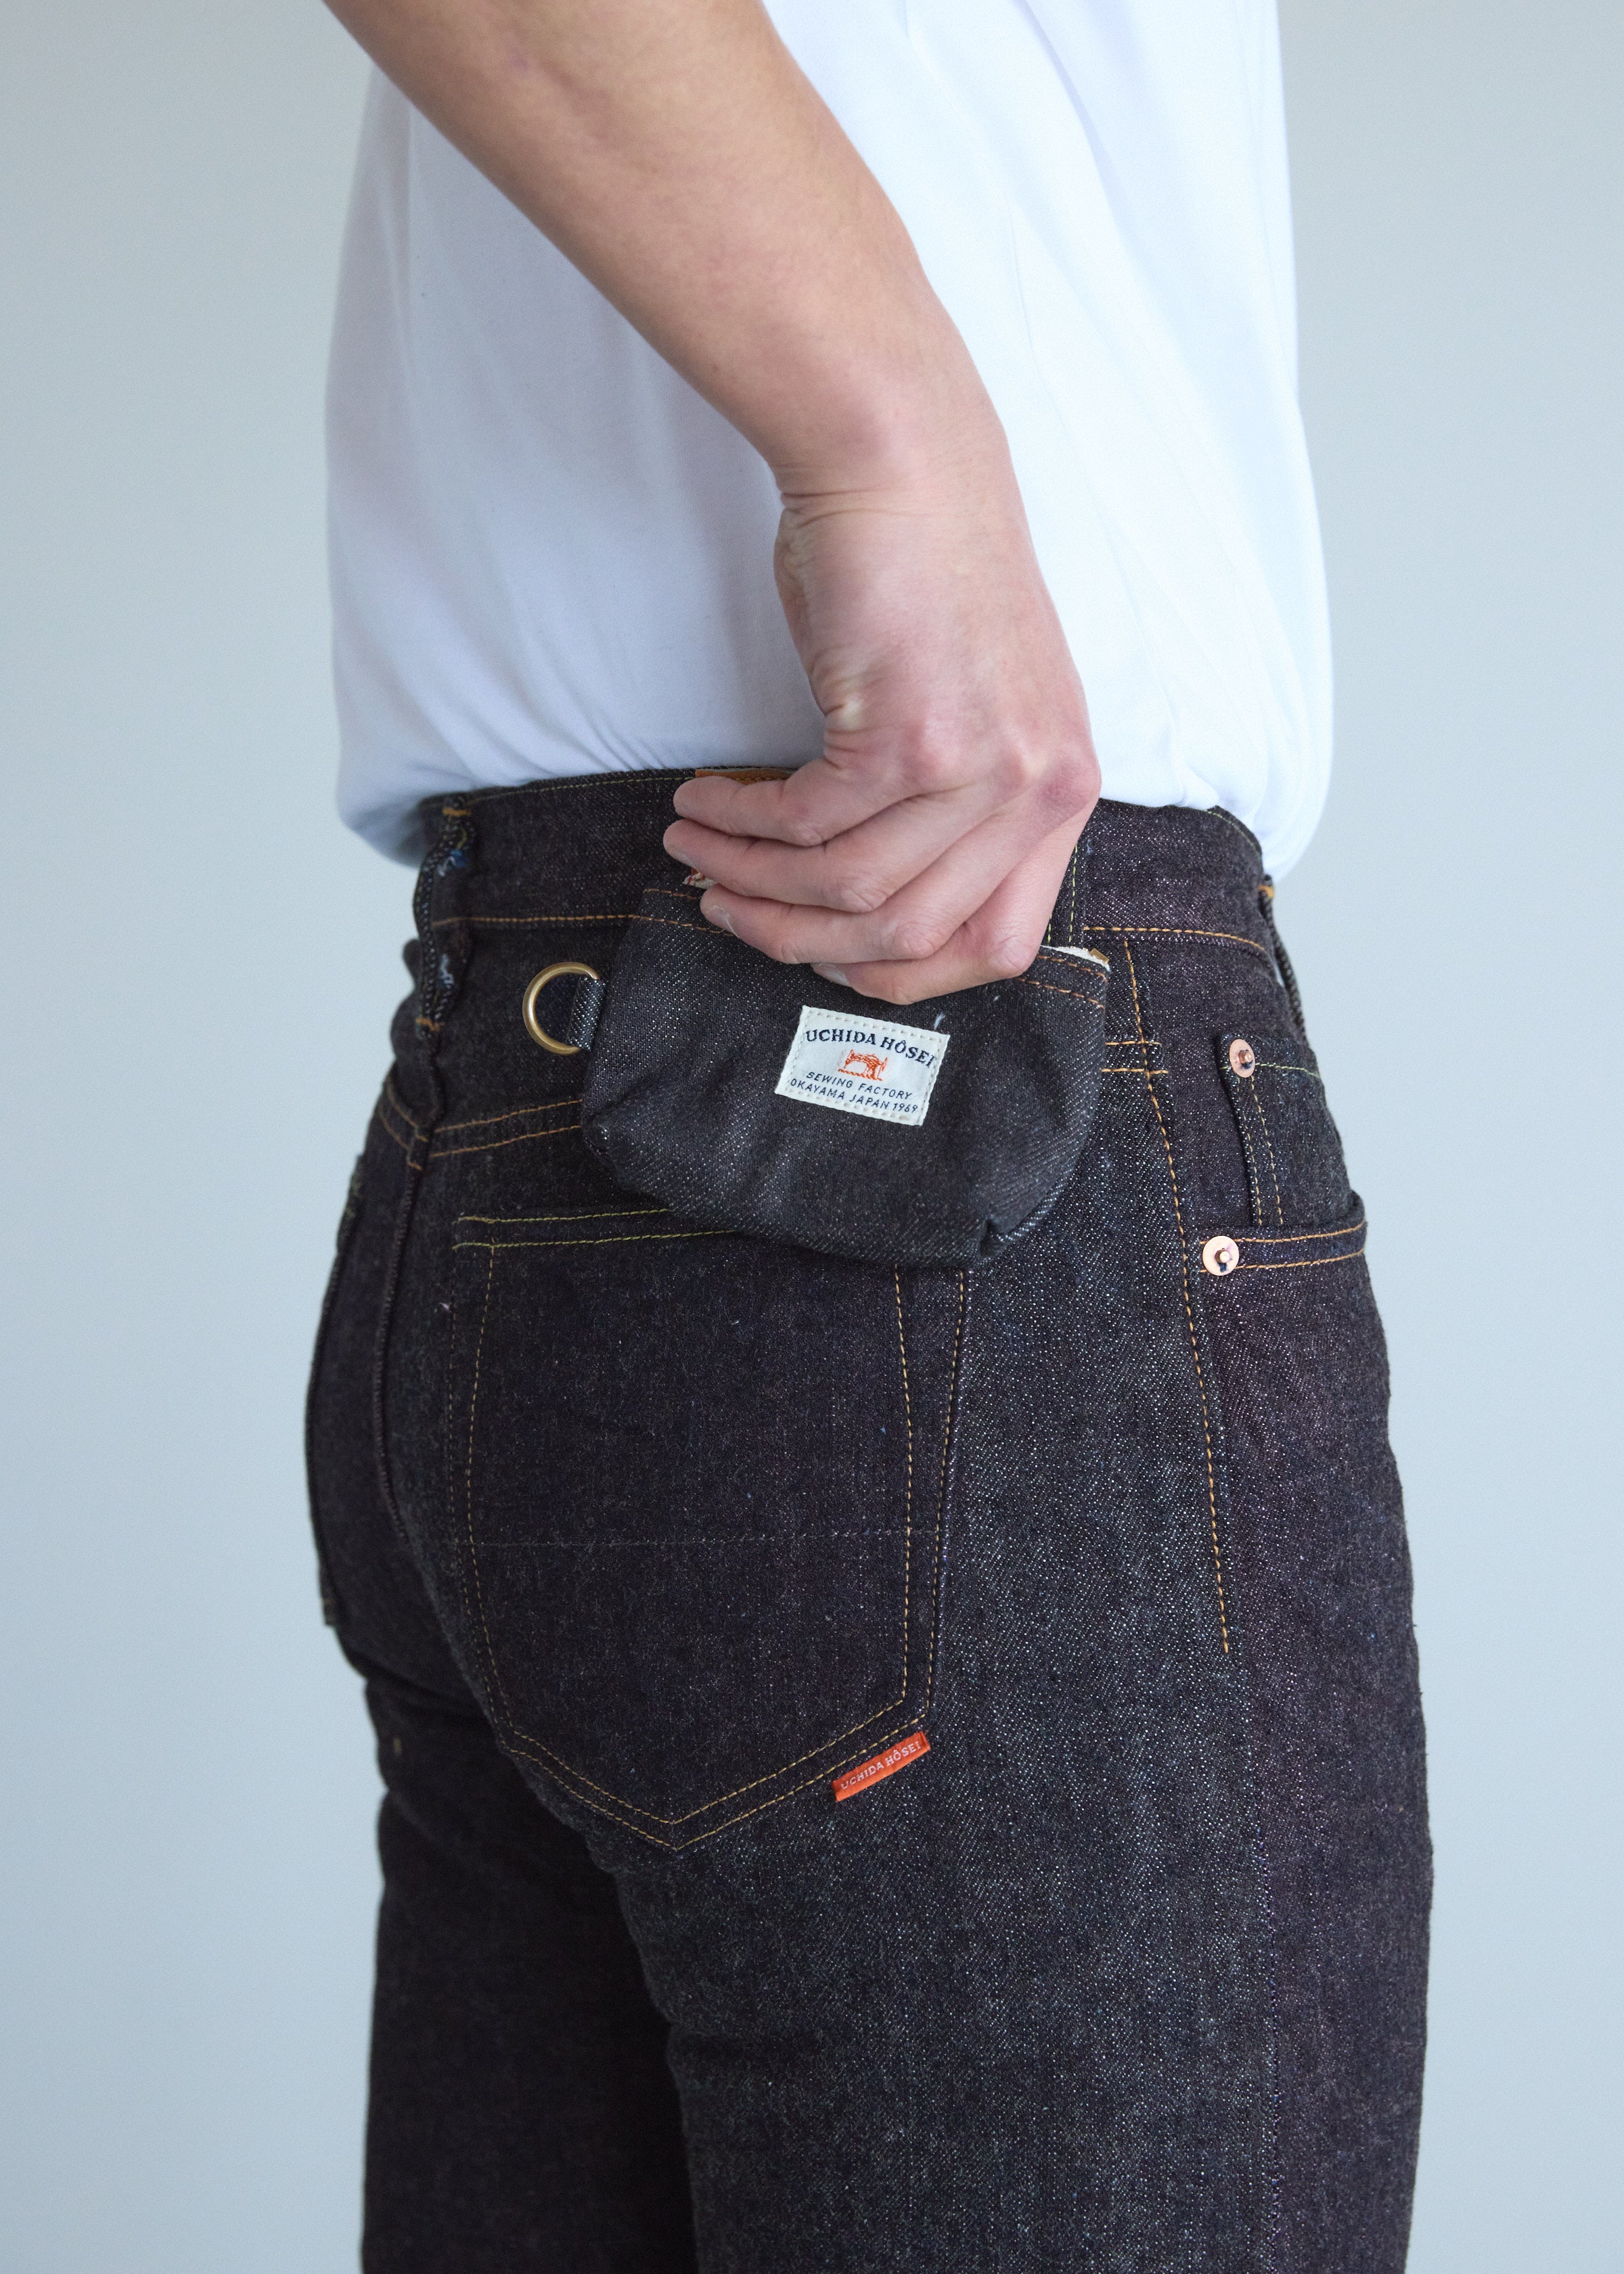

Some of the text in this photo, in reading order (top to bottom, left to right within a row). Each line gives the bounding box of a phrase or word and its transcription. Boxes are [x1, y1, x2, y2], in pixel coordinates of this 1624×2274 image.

[806, 1029, 936, 1068] UCHIDA HÔSEI
[790, 1078, 918, 1113] OKAYAMA JAPAN 1969
[807, 1071, 912, 1100] SEWING FACTORY
[840, 1741, 922, 1789] UCHIDA HÔSEI
